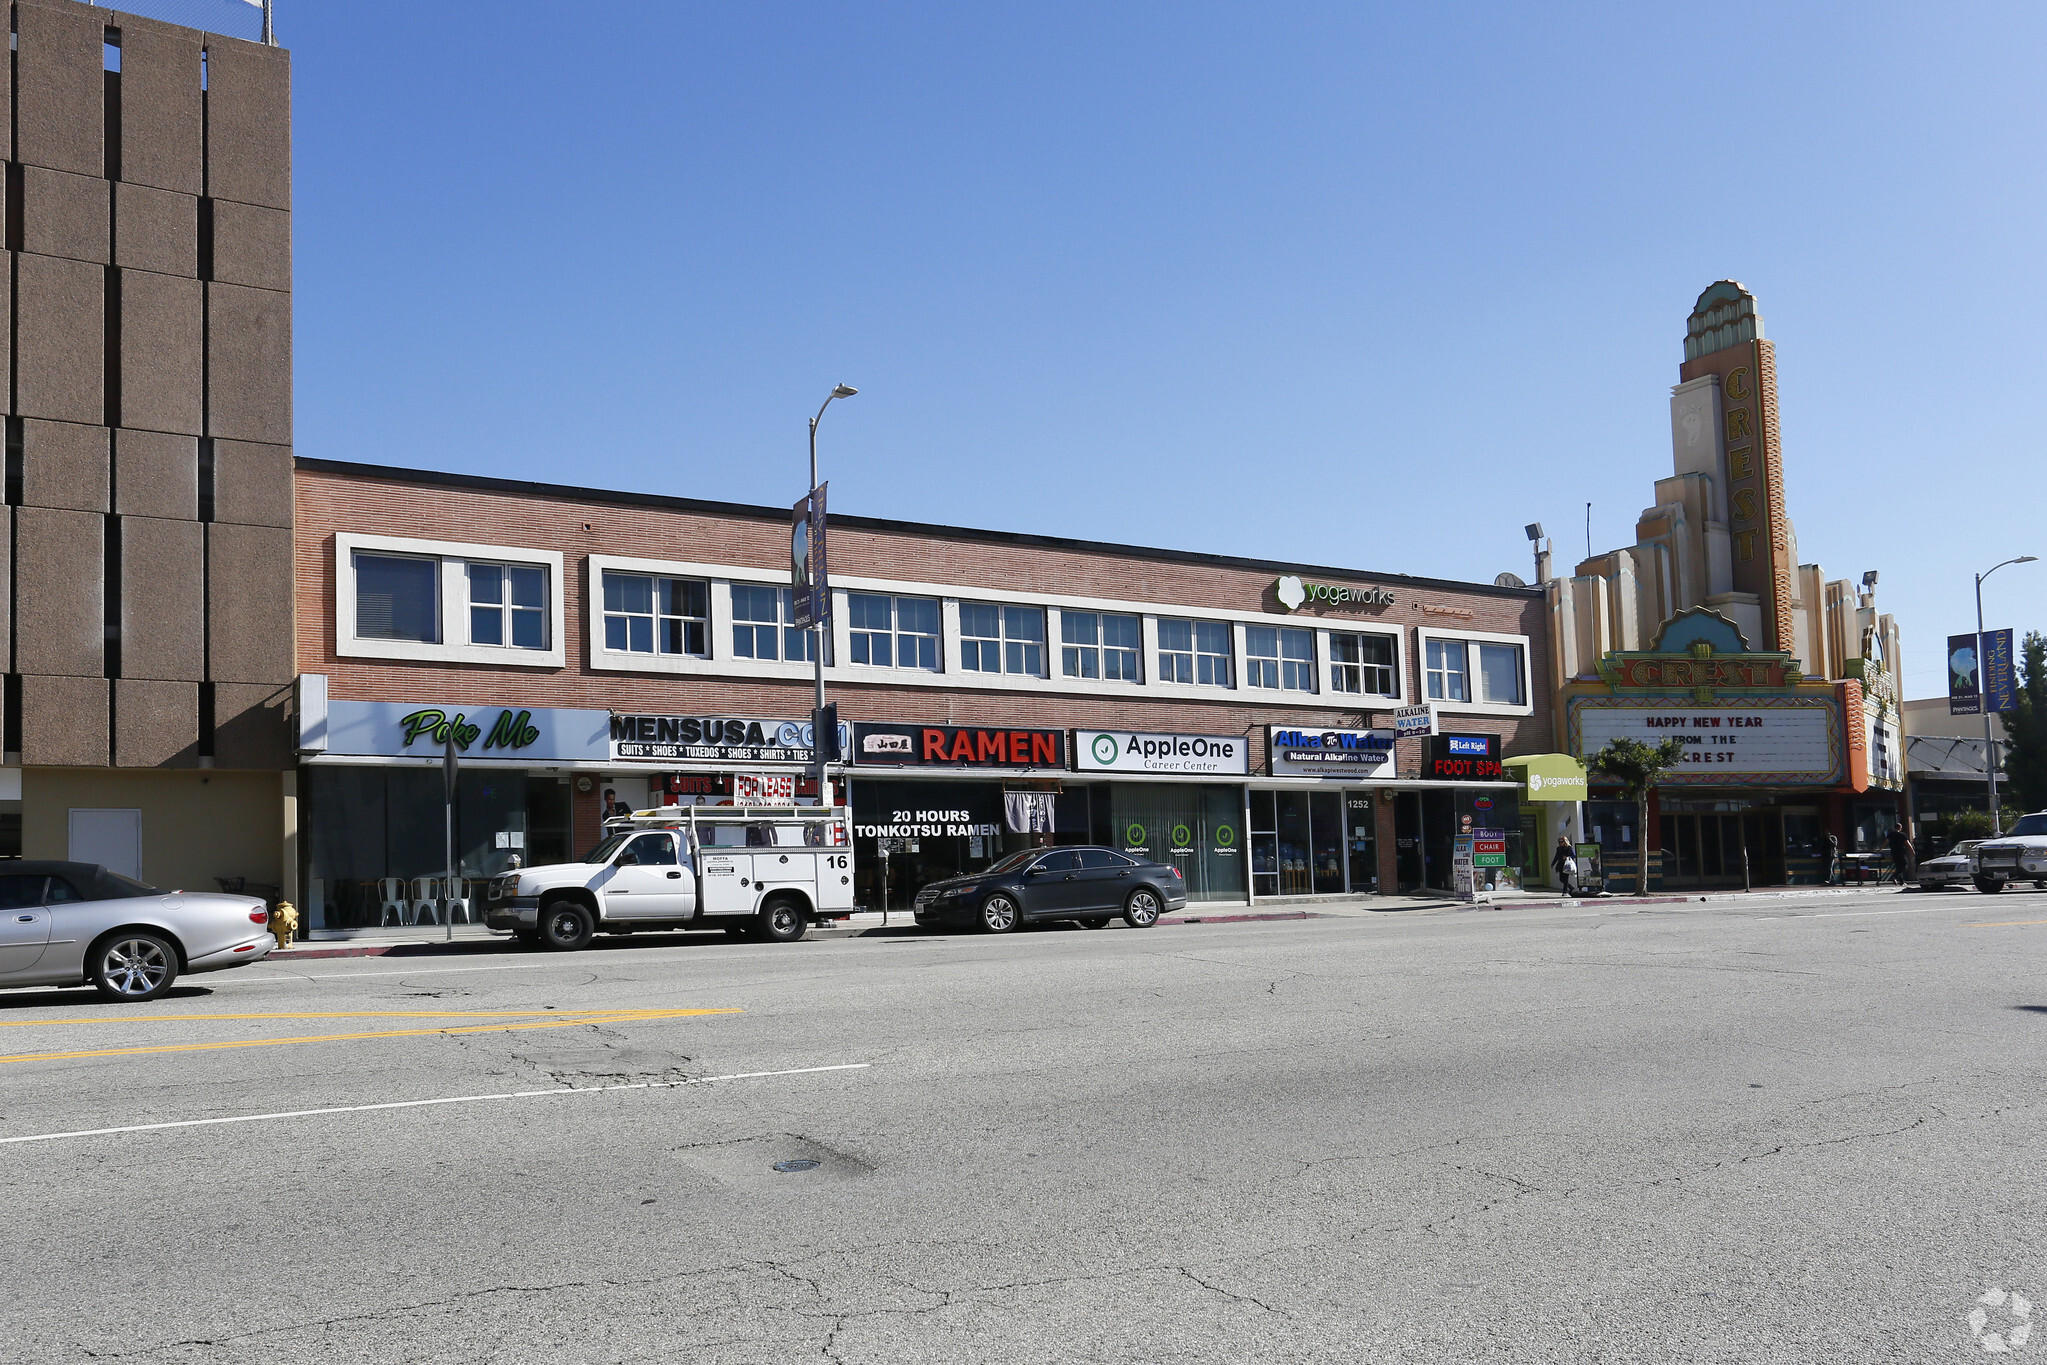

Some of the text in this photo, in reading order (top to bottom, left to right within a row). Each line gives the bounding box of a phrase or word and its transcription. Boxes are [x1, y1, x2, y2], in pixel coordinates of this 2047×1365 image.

[1725, 366, 1760, 562] CREST
[1307, 584, 1395, 606] yogaworks
[1631, 660, 1775, 687] CREST
[1988, 650, 1997, 693] FINDING
[1996, 631, 2011, 709] NEVERLAND
[1396, 706, 1430, 718] ALKALINE
[401, 709, 540, 750] Poke Me
[1397, 716, 1430, 728] WATER
[1646, 716, 1763, 728] HAPPY NEW YEAR
[923, 728, 1056, 764] RAMEN
[1126, 735, 1234, 759] AppleOne
[1276, 731, 1321, 749] Alka
[1339, 733, 1394, 750] Water
[1459, 741, 1487, 752] Left Right
[1672, 735, 1737, 745] FROM THE
[621, 743, 809, 761] SUITS SHOES TUXEDOS SHOES SHIRTS TIES
[1290, 752, 1385, 763] Natural Alkaline Water
[1144, 759, 1218, 771] Career Center
[1435, 759, 1503, 776] FOOT SPA
[670, 776, 712, 793] SUITS
[738, 775, 759, 797] FOR
[761, 777, 792, 798] LEASE
[1543, 775, 1585, 788] yogaworks
[1347, 800, 1369, 809] 1252
[892, 810, 970, 823] 20 HOURS
[855, 825, 943, 838] TONKOTSU
[946, 823, 1000, 837] RAMEN
[1479, 843, 1500, 851] CHAIR
[826, 855, 848, 869] 16
